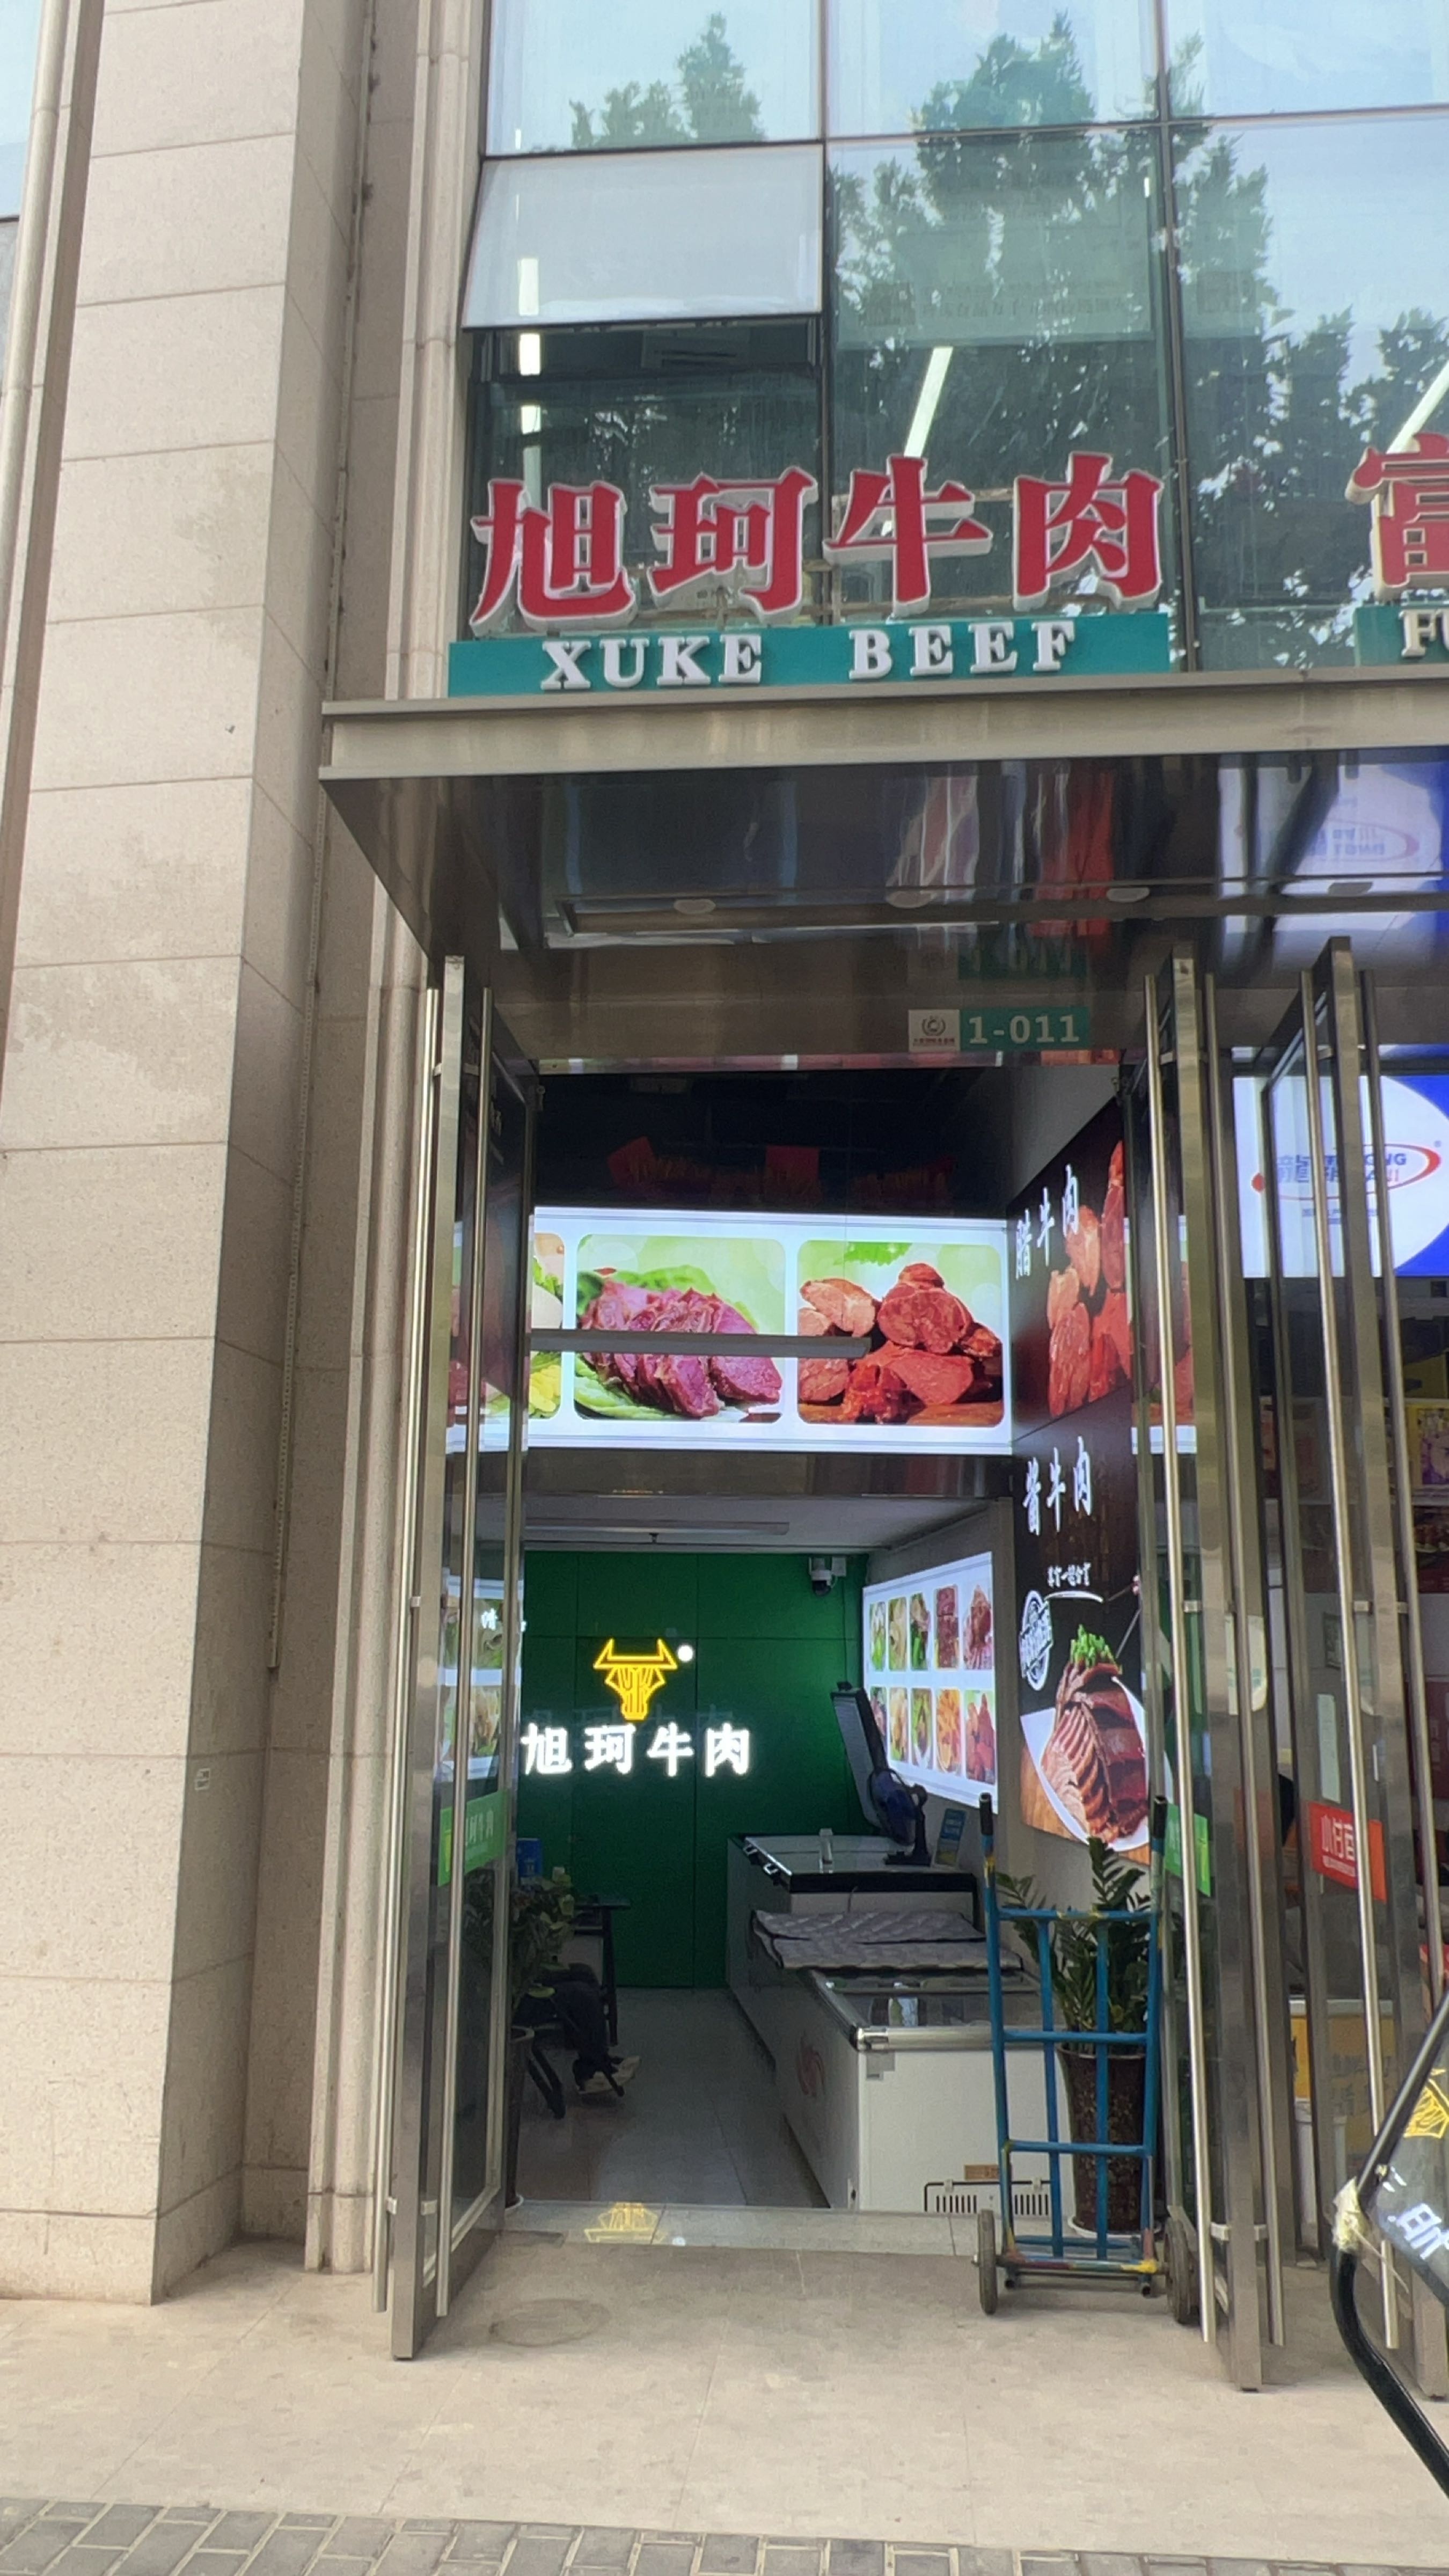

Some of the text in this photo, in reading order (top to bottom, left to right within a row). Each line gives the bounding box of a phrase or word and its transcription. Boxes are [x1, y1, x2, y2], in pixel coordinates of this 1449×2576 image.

[470, 451, 1165, 632] 旭珂牛肉
[540, 620, 1075, 690] XUKE BEEF
[968, 1014, 1080, 1044] 1-011
[521, 1722, 750, 1777] 旭珂牛肉
